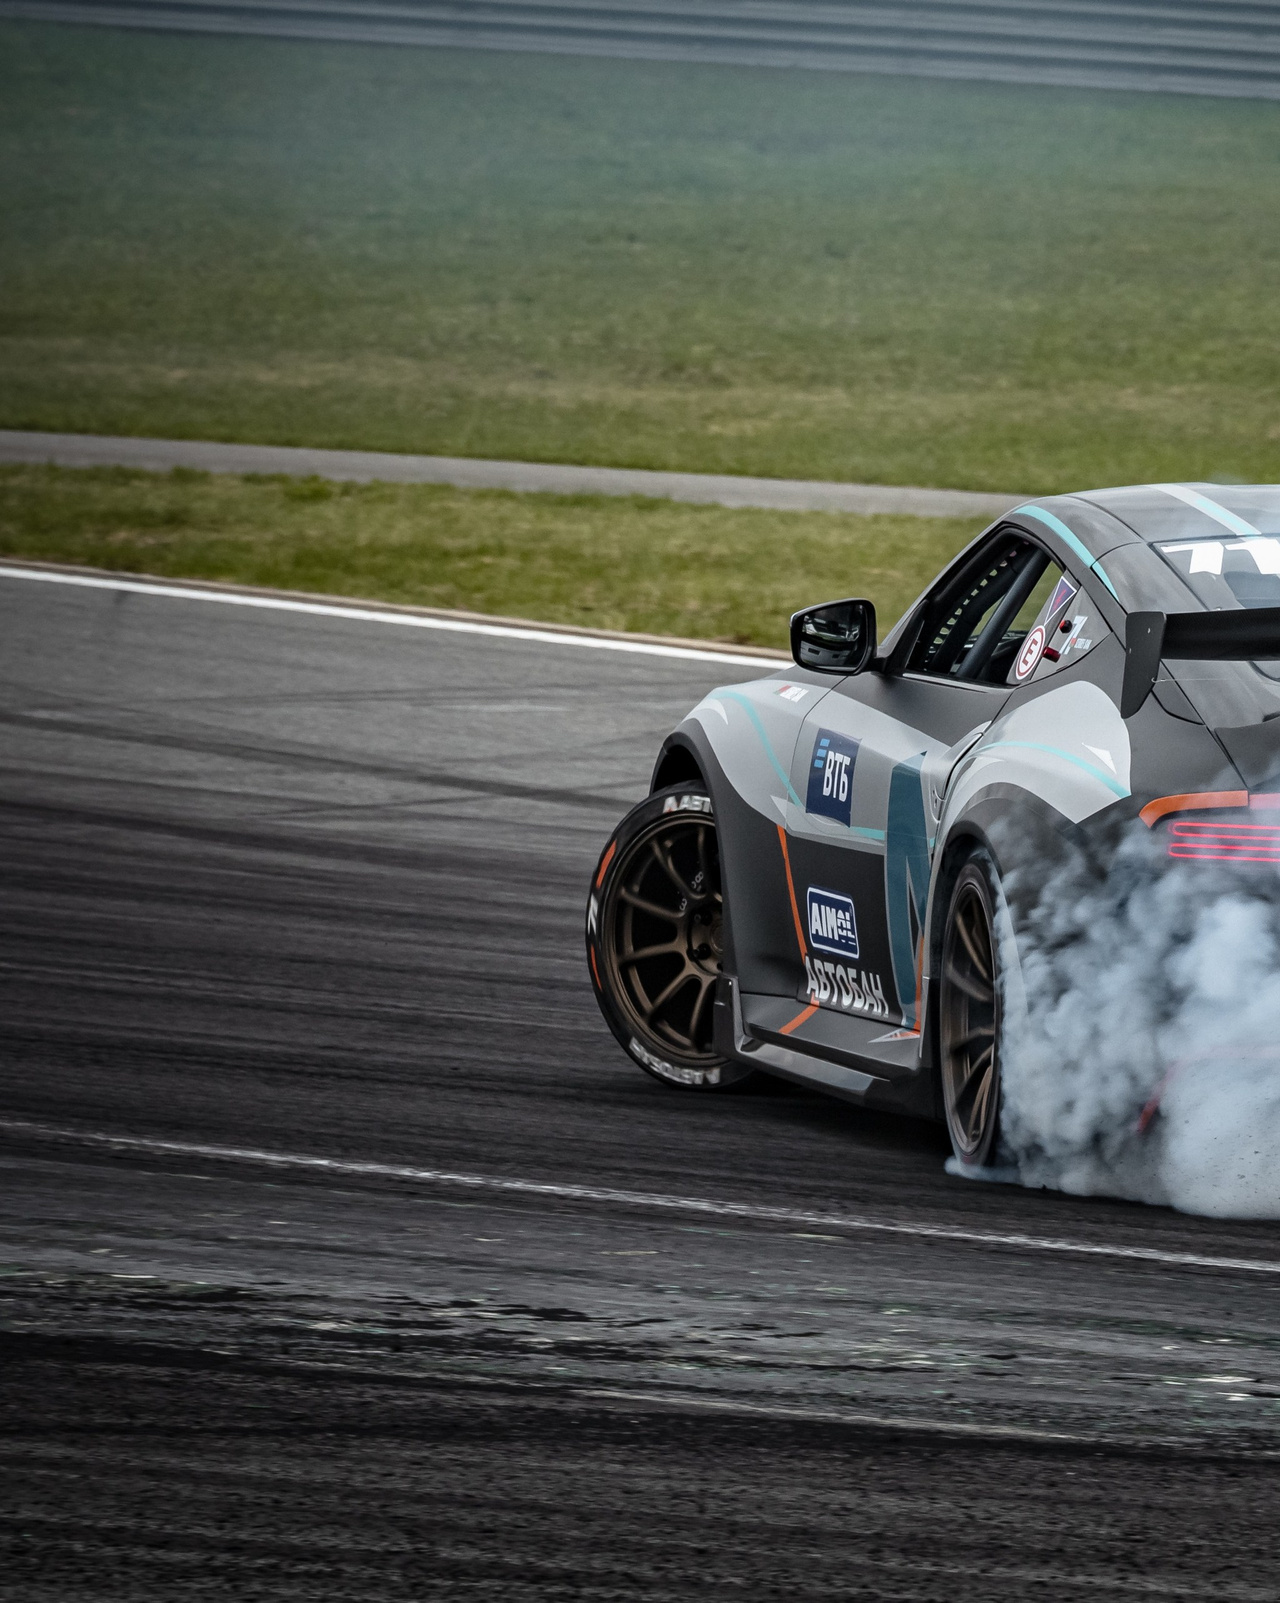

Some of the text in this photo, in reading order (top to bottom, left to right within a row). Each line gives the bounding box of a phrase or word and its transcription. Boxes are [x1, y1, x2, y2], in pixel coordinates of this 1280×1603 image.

[1022, 638, 1039, 667] E
[822, 750, 851, 802] ВТБ
[811, 902, 856, 945] AIMOL
[805, 955, 889, 1018] АВТОБАН
